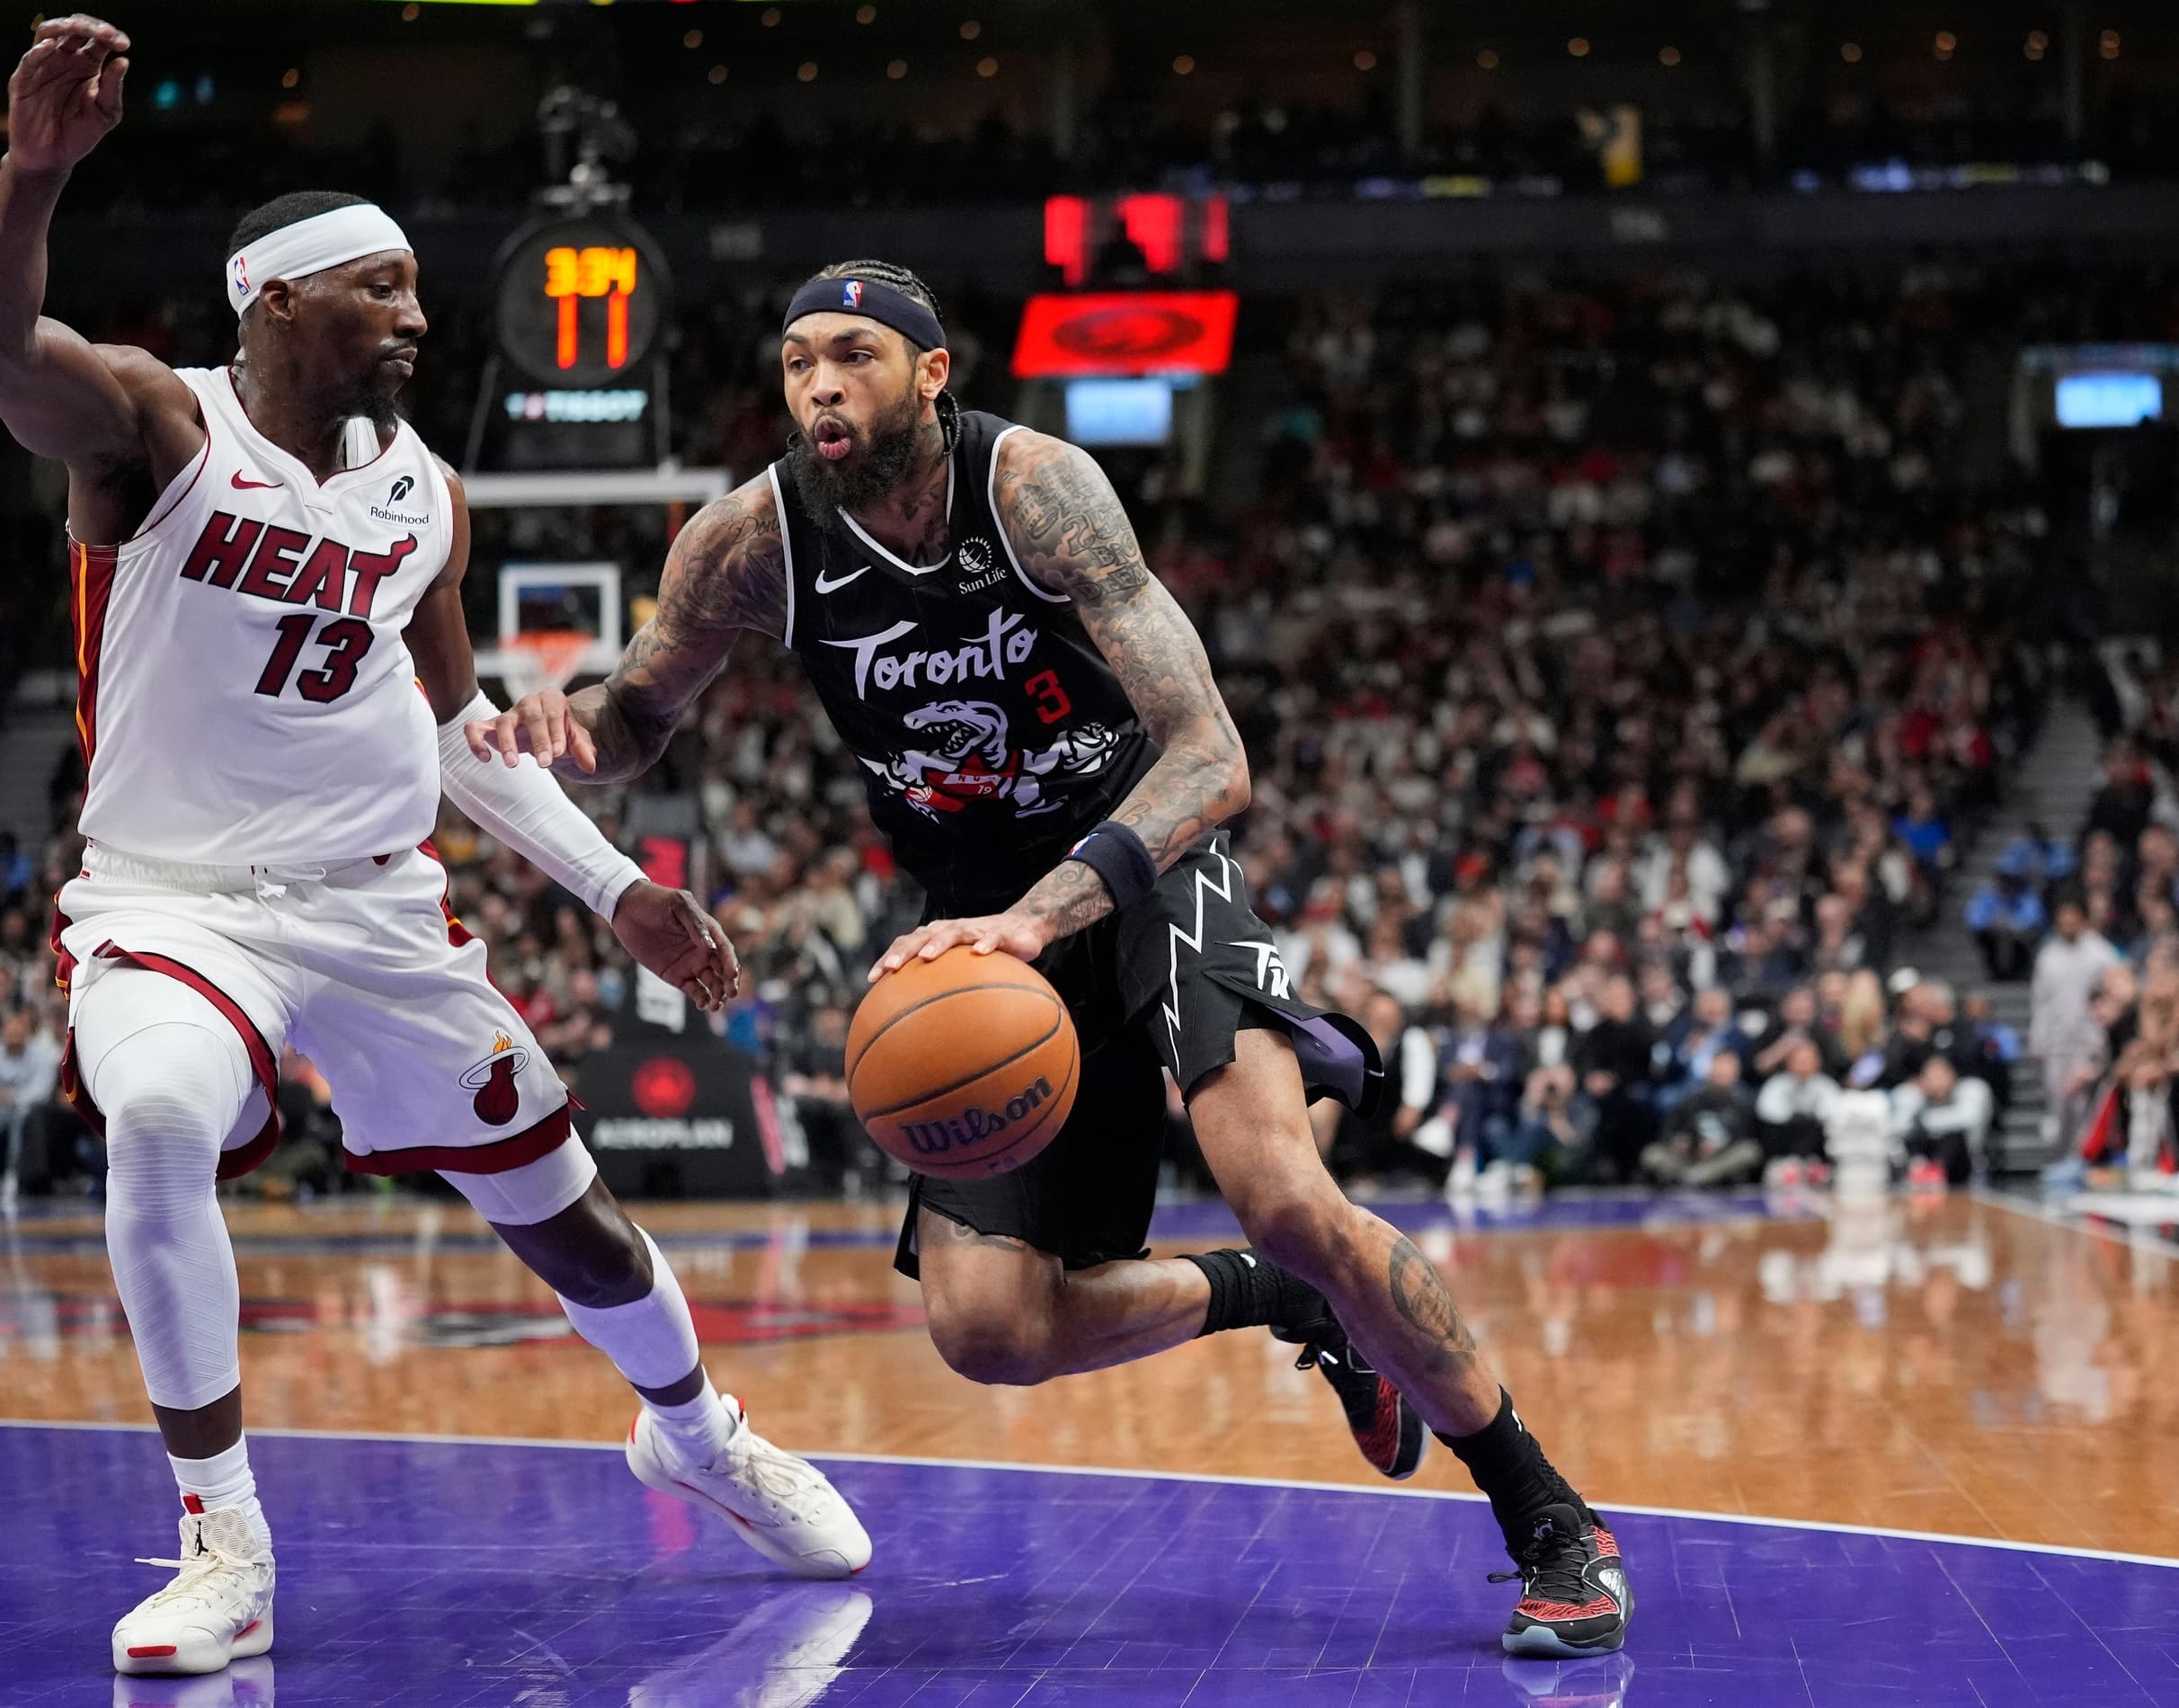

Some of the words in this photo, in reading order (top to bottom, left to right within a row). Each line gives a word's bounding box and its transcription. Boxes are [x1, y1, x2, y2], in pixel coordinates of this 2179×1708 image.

[557, 290, 628, 370] 11
[370, 506, 429, 524] Robinhood
[180, 510, 418, 620] HEAT
[958, 580, 985, 594] Sun
[984, 566, 1007, 585] Life
[253, 613, 376, 704] 13
[818, 605, 1037, 701] Toronto
[1024, 669, 1072, 725] 3
[900, 1076, 1054, 1154] Wilson
